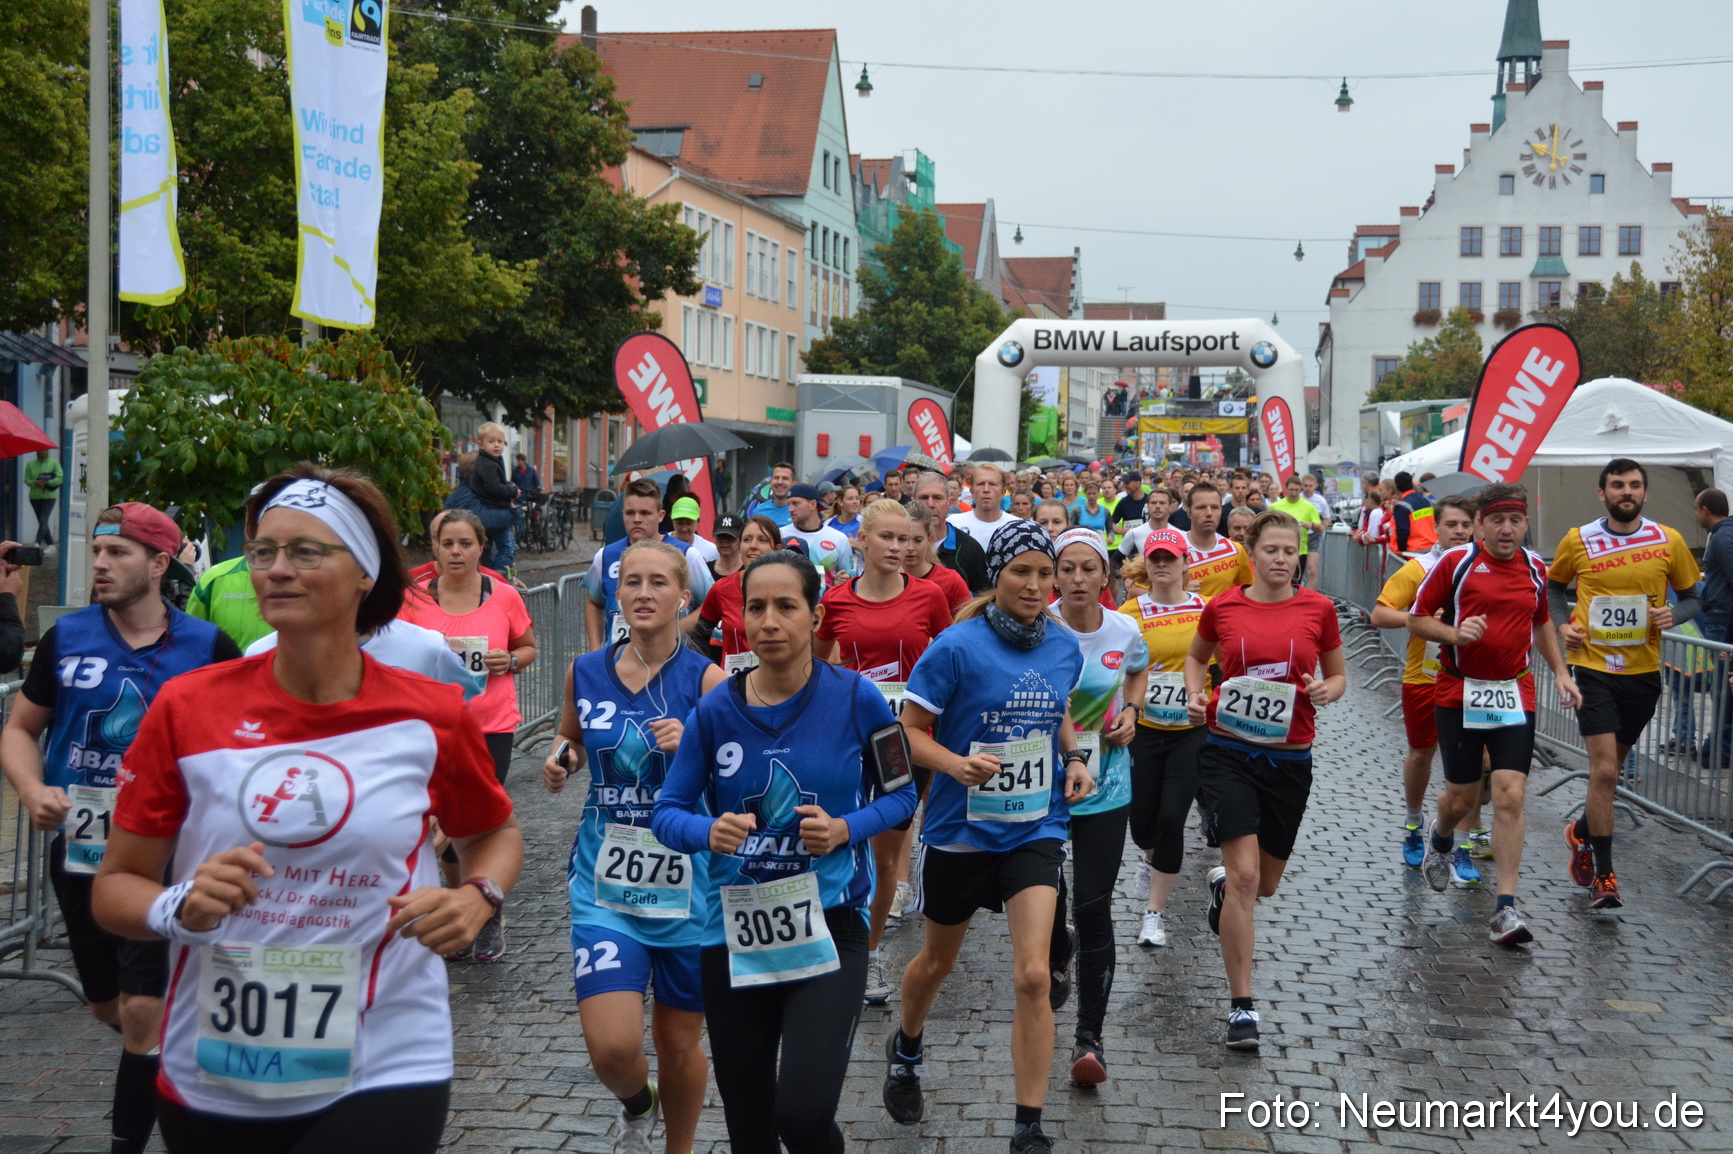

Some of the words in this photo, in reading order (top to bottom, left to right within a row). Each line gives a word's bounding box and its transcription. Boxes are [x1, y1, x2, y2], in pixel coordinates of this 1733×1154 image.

[351, 31, 380, 44] FAIRTRADE
[1033, 329, 1105, 351] BMW
[1112, 330, 1240, 356] Laufsport
[1470, 346, 1565, 483] REWE
[1181, 421, 1205, 432] ZIEL
[1266, 405, 1291, 472] REWE
[1149, 532, 1179, 547] NIKE
[1213, 559, 1240, 573] BÖGL
[1591, 556, 1627, 573] MAX
[1631, 548, 1670, 566] BÖGL
[1143, 619, 1172, 631] MAX
[1601, 608, 1638, 627] 294
[1605, 631, 1633, 640] Roland
[60, 655, 108, 689] 13
[870, 668, 889, 679] DEHN
[1257, 667, 1276, 676] DEHN
[1254, 681, 1289, 694] BOCK
[1224, 689, 1287, 724] 2132
[1470, 689, 1516, 709] 2205
[577, 698, 617, 729] 22
[1002, 709, 1043, 719] Neumarkter
[1162, 710, 1183, 721] Katja
[1486, 713, 1503, 722] Max
[234, 729, 266, 740] erima
[1236, 719, 1266, 735] Kristin
[1011, 741, 1047, 754] BOCK
[715, 741, 743, 778] 9
[979, 756, 1045, 792] 2541
[1004, 799, 1025, 811] Eva
[605, 846, 685, 886] 2675
[748, 860, 802, 871] BASKETS
[283, 865, 321, 884] MIT
[329, 867, 381, 888] HERZ
[622, 890, 658, 905] Paula
[757, 878, 809, 899] BOCK
[276, 889, 283, 903] /
[287, 890, 306, 905] Dr.
[309, 892, 358, 908] Röschl
[734, 899, 813, 948] 3037
[263, 948, 346, 969] BOCK
[575, 940, 622, 979] 22
[211, 976, 343, 1040] 3017
[224, 1042, 283, 1078] INA
